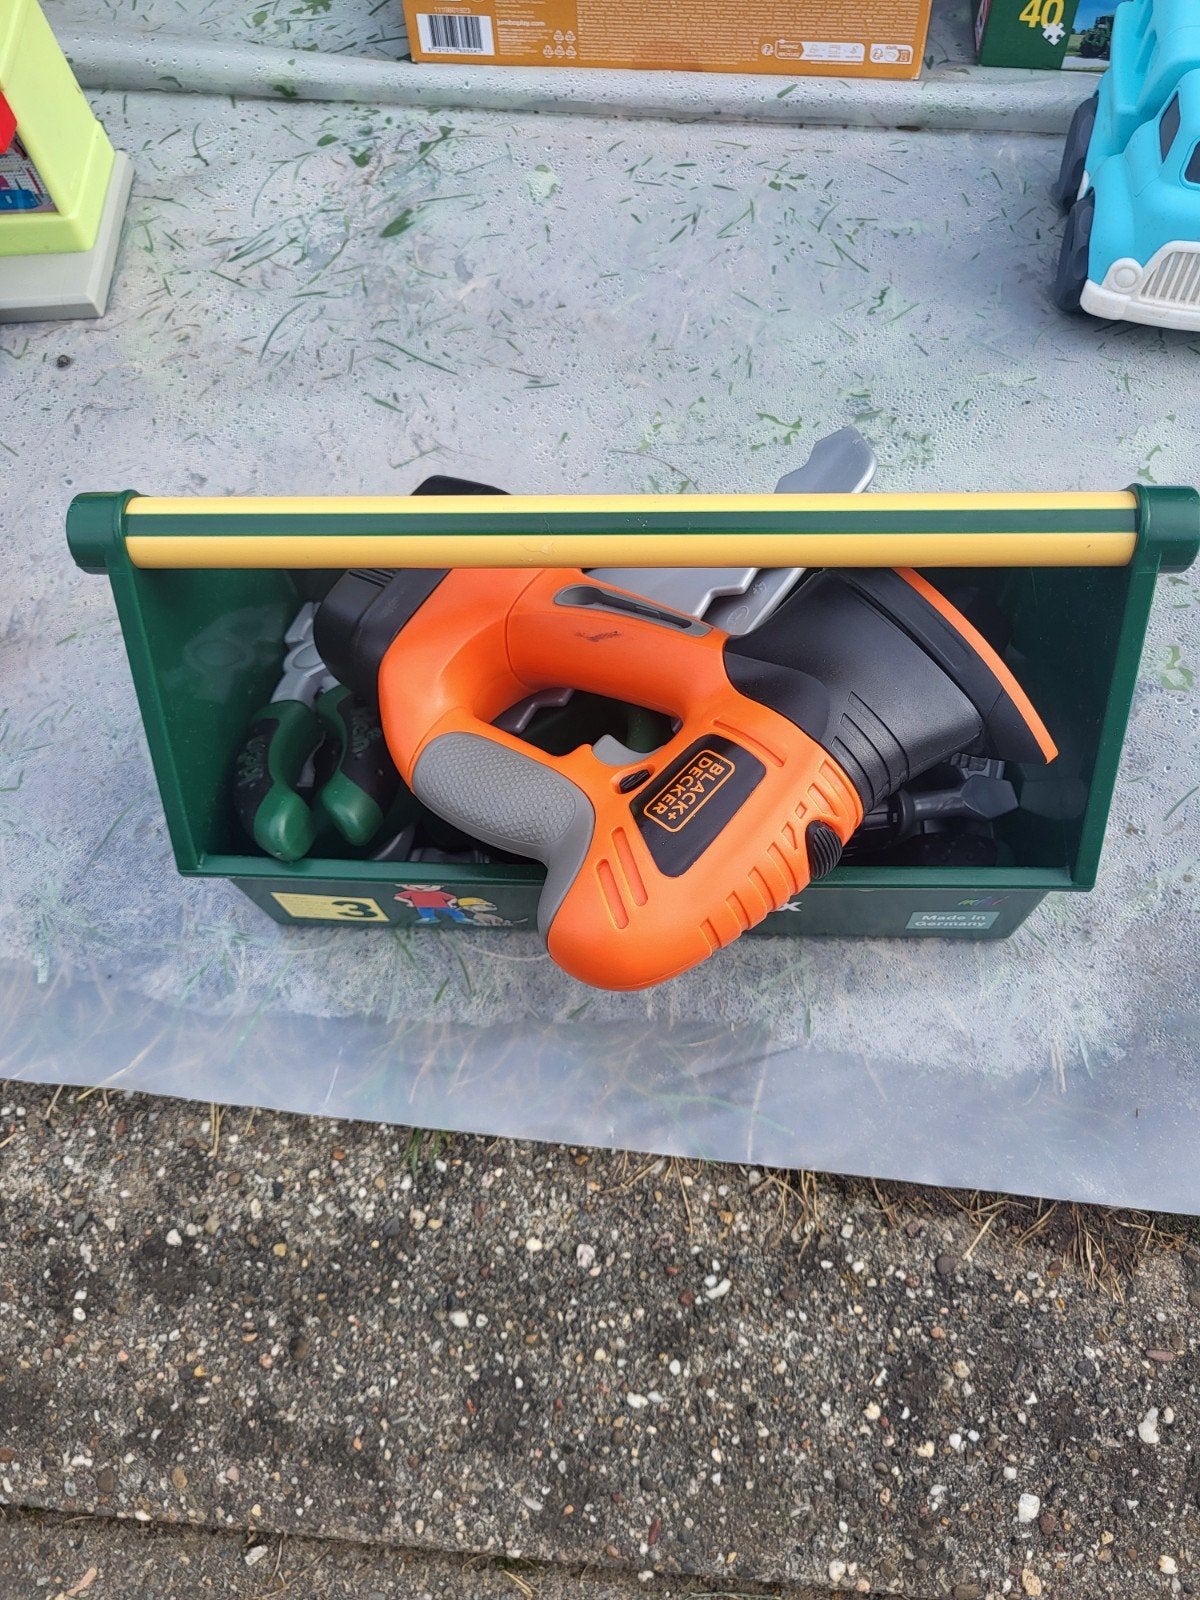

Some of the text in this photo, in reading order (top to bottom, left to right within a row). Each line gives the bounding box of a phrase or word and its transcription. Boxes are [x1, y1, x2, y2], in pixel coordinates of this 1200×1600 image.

[1018, 0, 1064, 28] 40
[652, 757, 714, 815] DECKER
[668, 763, 725, 820] BLACK+
[331, 900, 379, 918] 3
